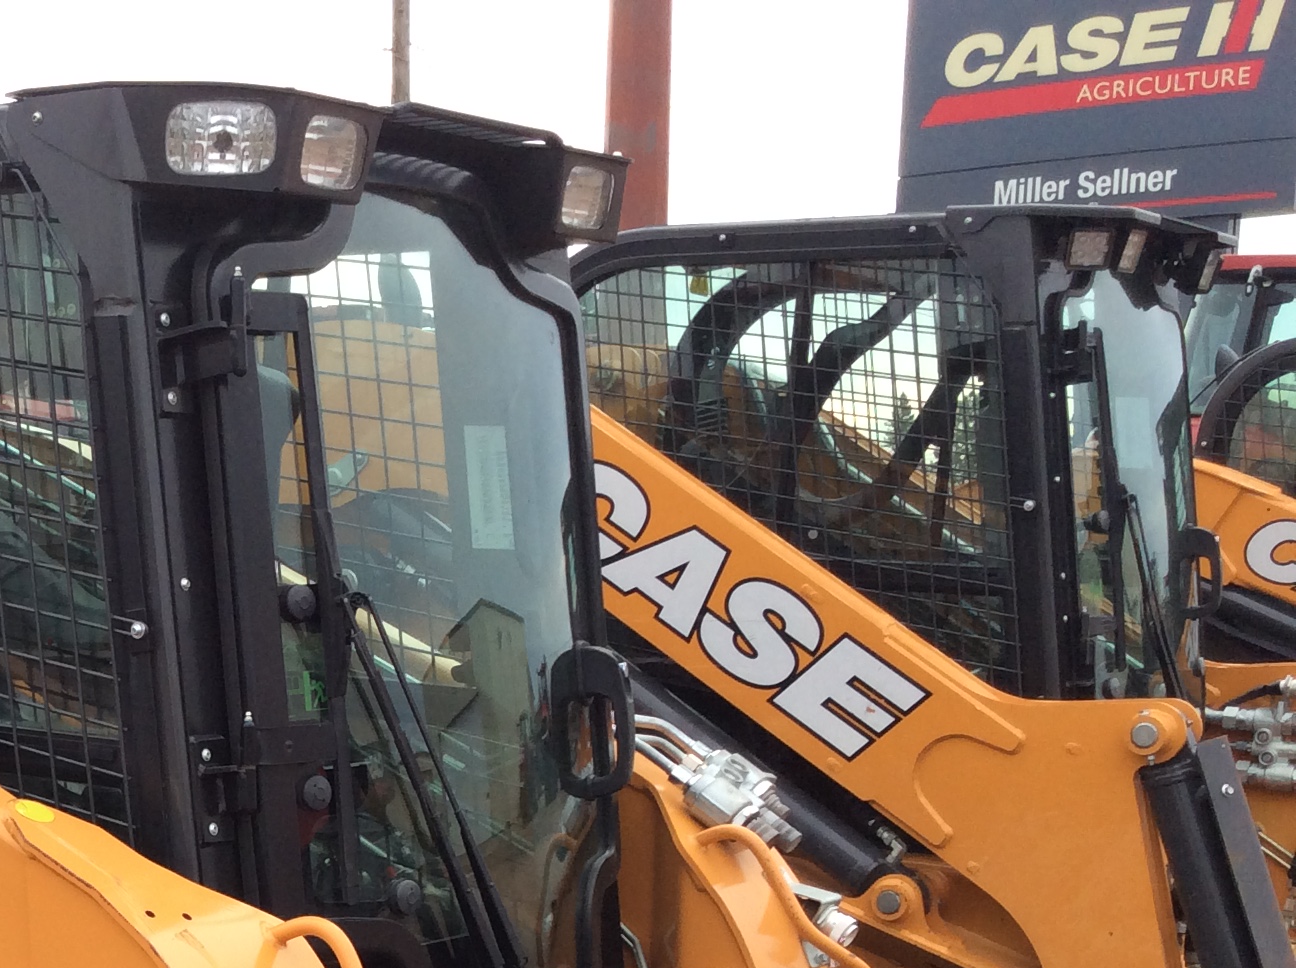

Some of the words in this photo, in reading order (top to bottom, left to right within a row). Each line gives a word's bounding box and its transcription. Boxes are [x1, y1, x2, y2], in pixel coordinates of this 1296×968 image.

[944, 6, 1191, 88] CASE
[1075, 65, 1252, 103] AGRICULTURE
[993, 174, 1071, 206] Miller
[1076, 166, 1178, 200] Sellner
